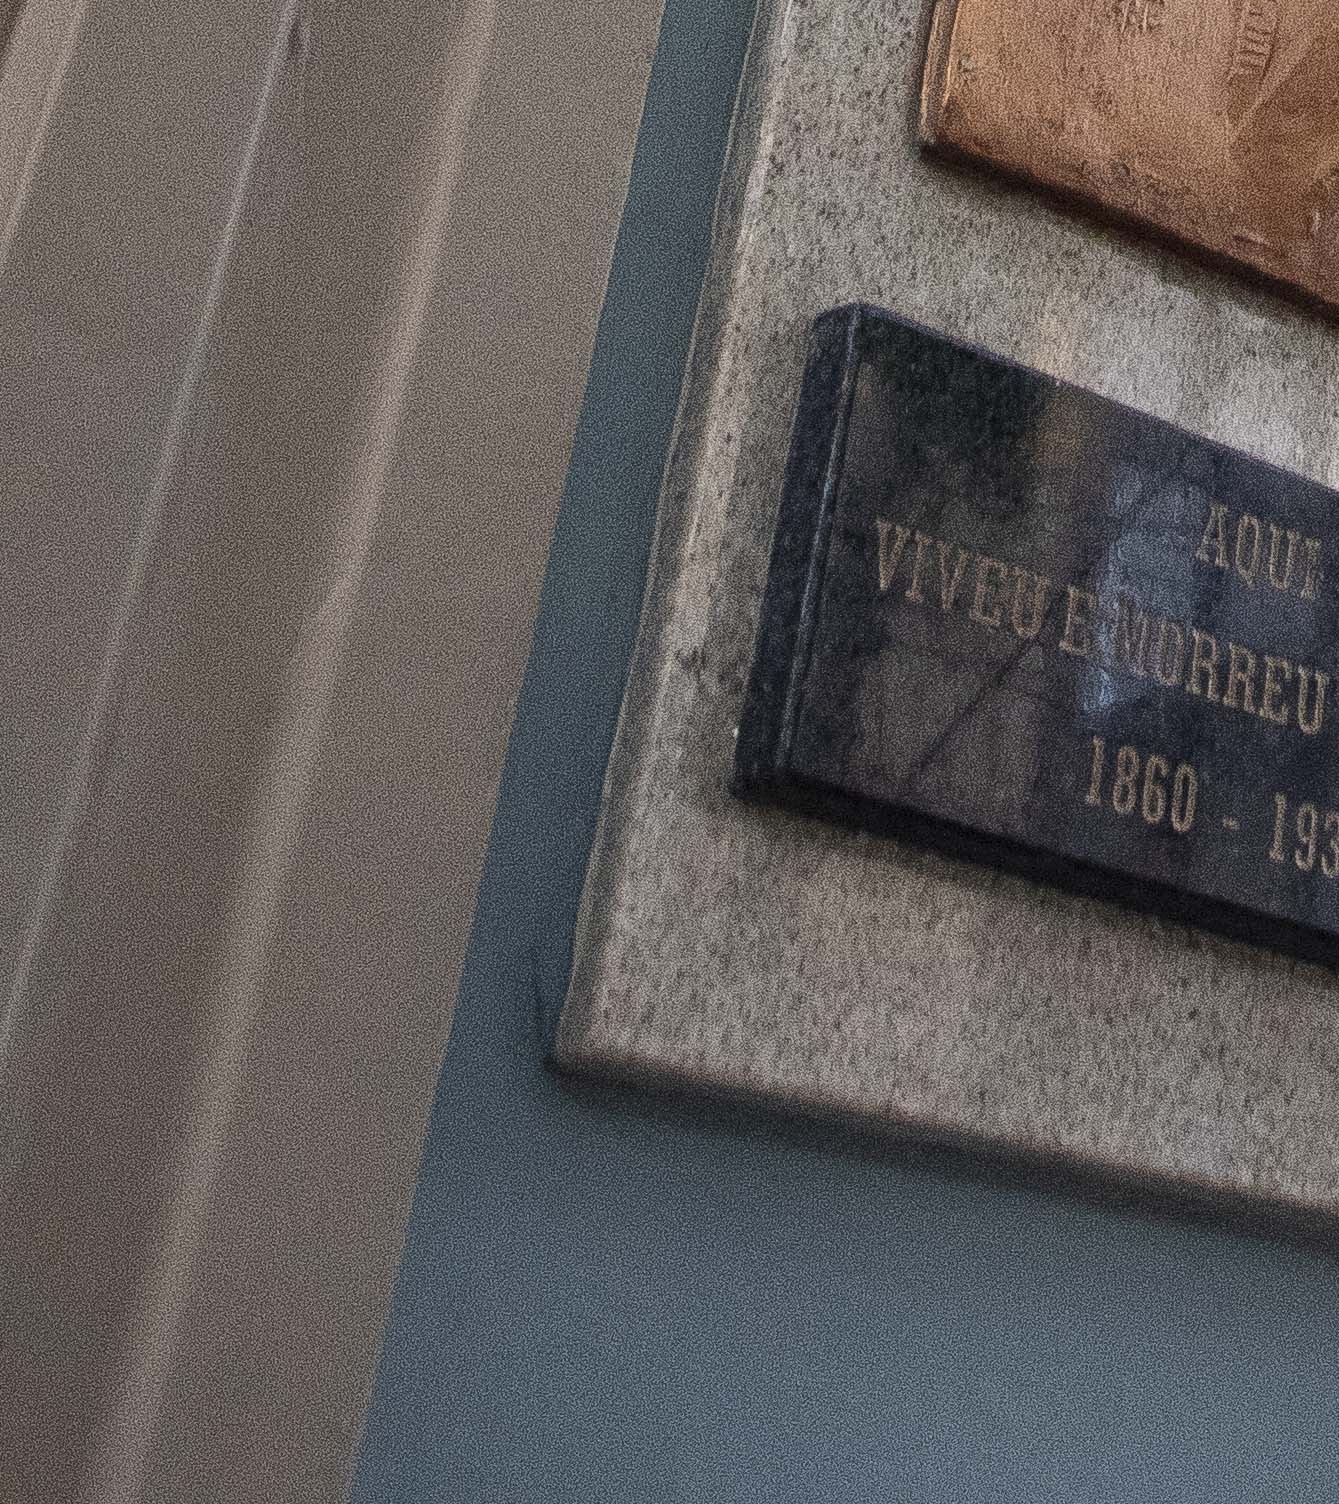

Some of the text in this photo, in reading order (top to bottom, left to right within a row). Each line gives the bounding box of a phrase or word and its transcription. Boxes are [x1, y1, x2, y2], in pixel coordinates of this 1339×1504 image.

[1195, 503, 1323, 602] AQUI
[873, 519, 1049, 639] VIVEU
[1059, 587, 1100, 654] E
[1110, 595, 1327, 736] MORREU
[1084, 739, 1198, 834] 1860
